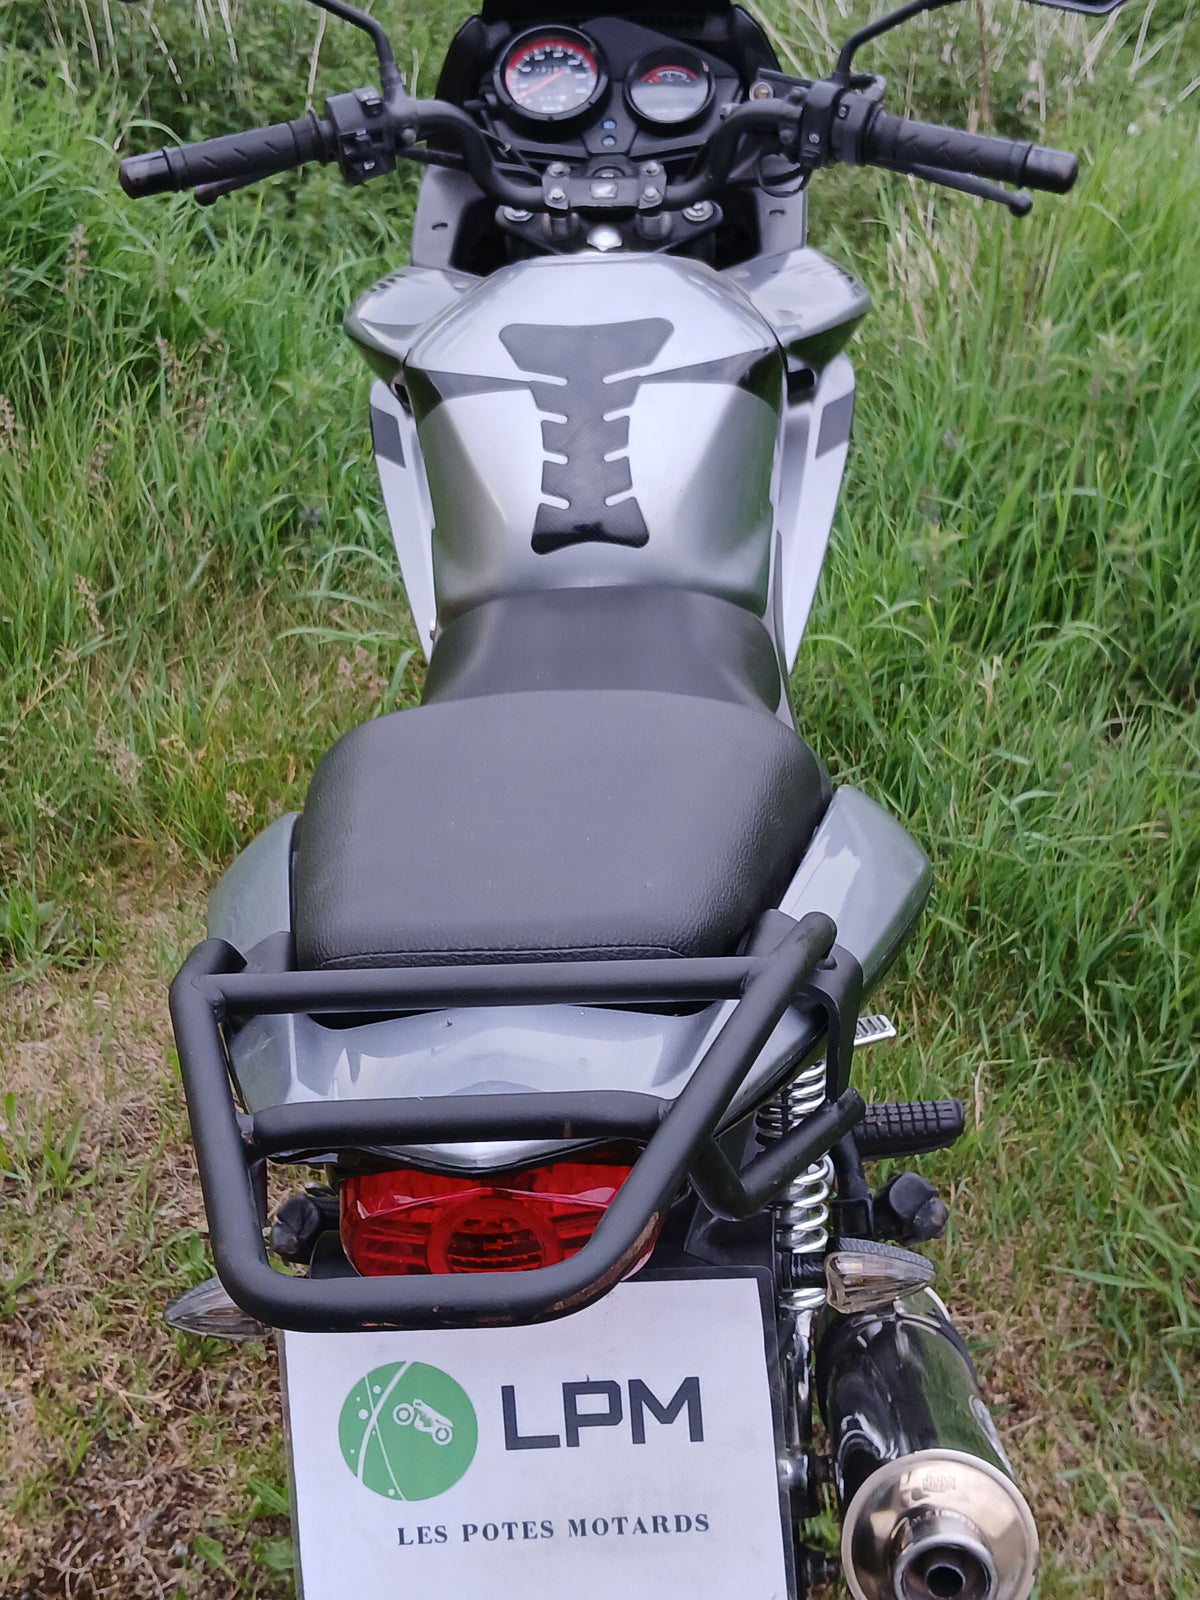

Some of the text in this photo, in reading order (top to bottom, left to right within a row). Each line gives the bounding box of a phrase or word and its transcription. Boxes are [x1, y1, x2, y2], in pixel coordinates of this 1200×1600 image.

[501, 1376, 704, 1451] LPM
[397, 1513, 710, 1546] LES POTES MOTARDS
